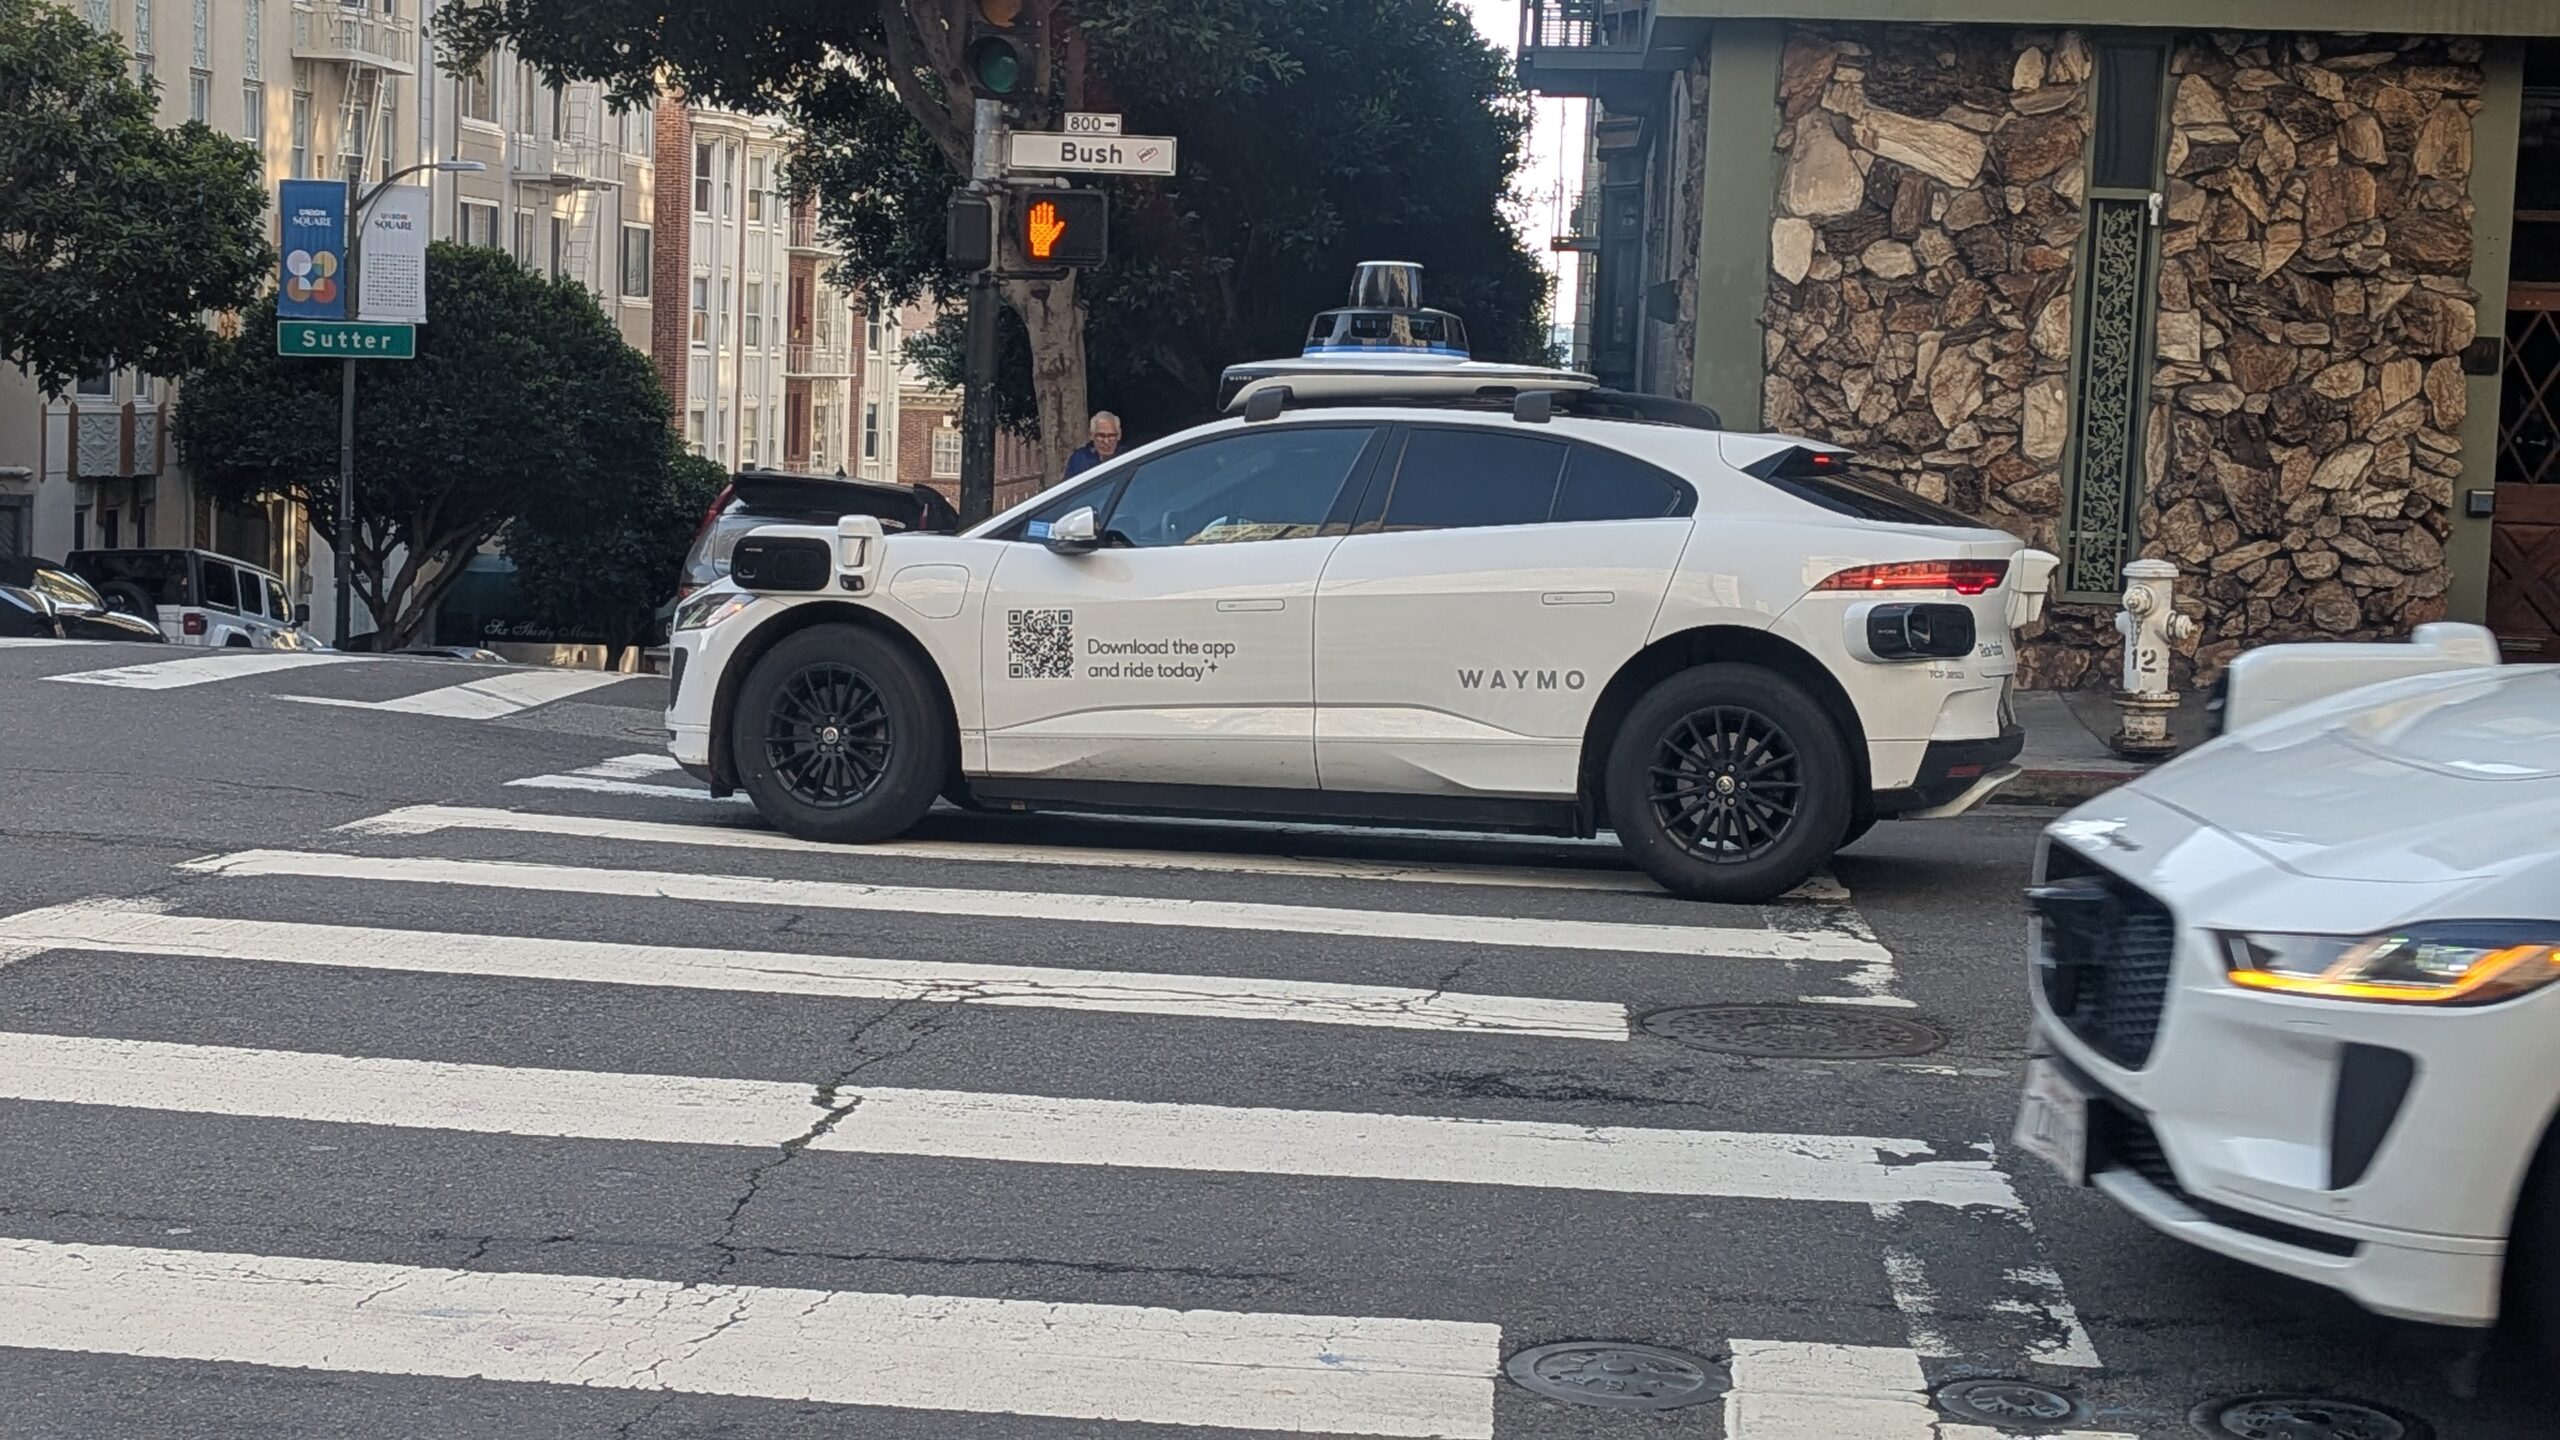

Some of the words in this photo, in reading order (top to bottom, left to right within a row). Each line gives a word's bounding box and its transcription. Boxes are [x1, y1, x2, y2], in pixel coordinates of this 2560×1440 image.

[1070, 117, 1101, 131] 800
[1061, 142, 1123, 164] Bush
[292, 215, 333, 228] SQUARE
[374, 220, 413, 231] SQUARE
[302, 329, 391, 349] Sutter
[1088, 639, 1168, 655] Download
[1172, 639, 1199, 655] the
[1202, 641, 1236, 659] app
[2131, 648, 2157, 673] 12
[1088, 662, 1120, 678] and
[1123, 662, 1154, 678] ride
[1157, 662, 1204, 682] today
[1457, 669, 1585, 690] WAYMO
